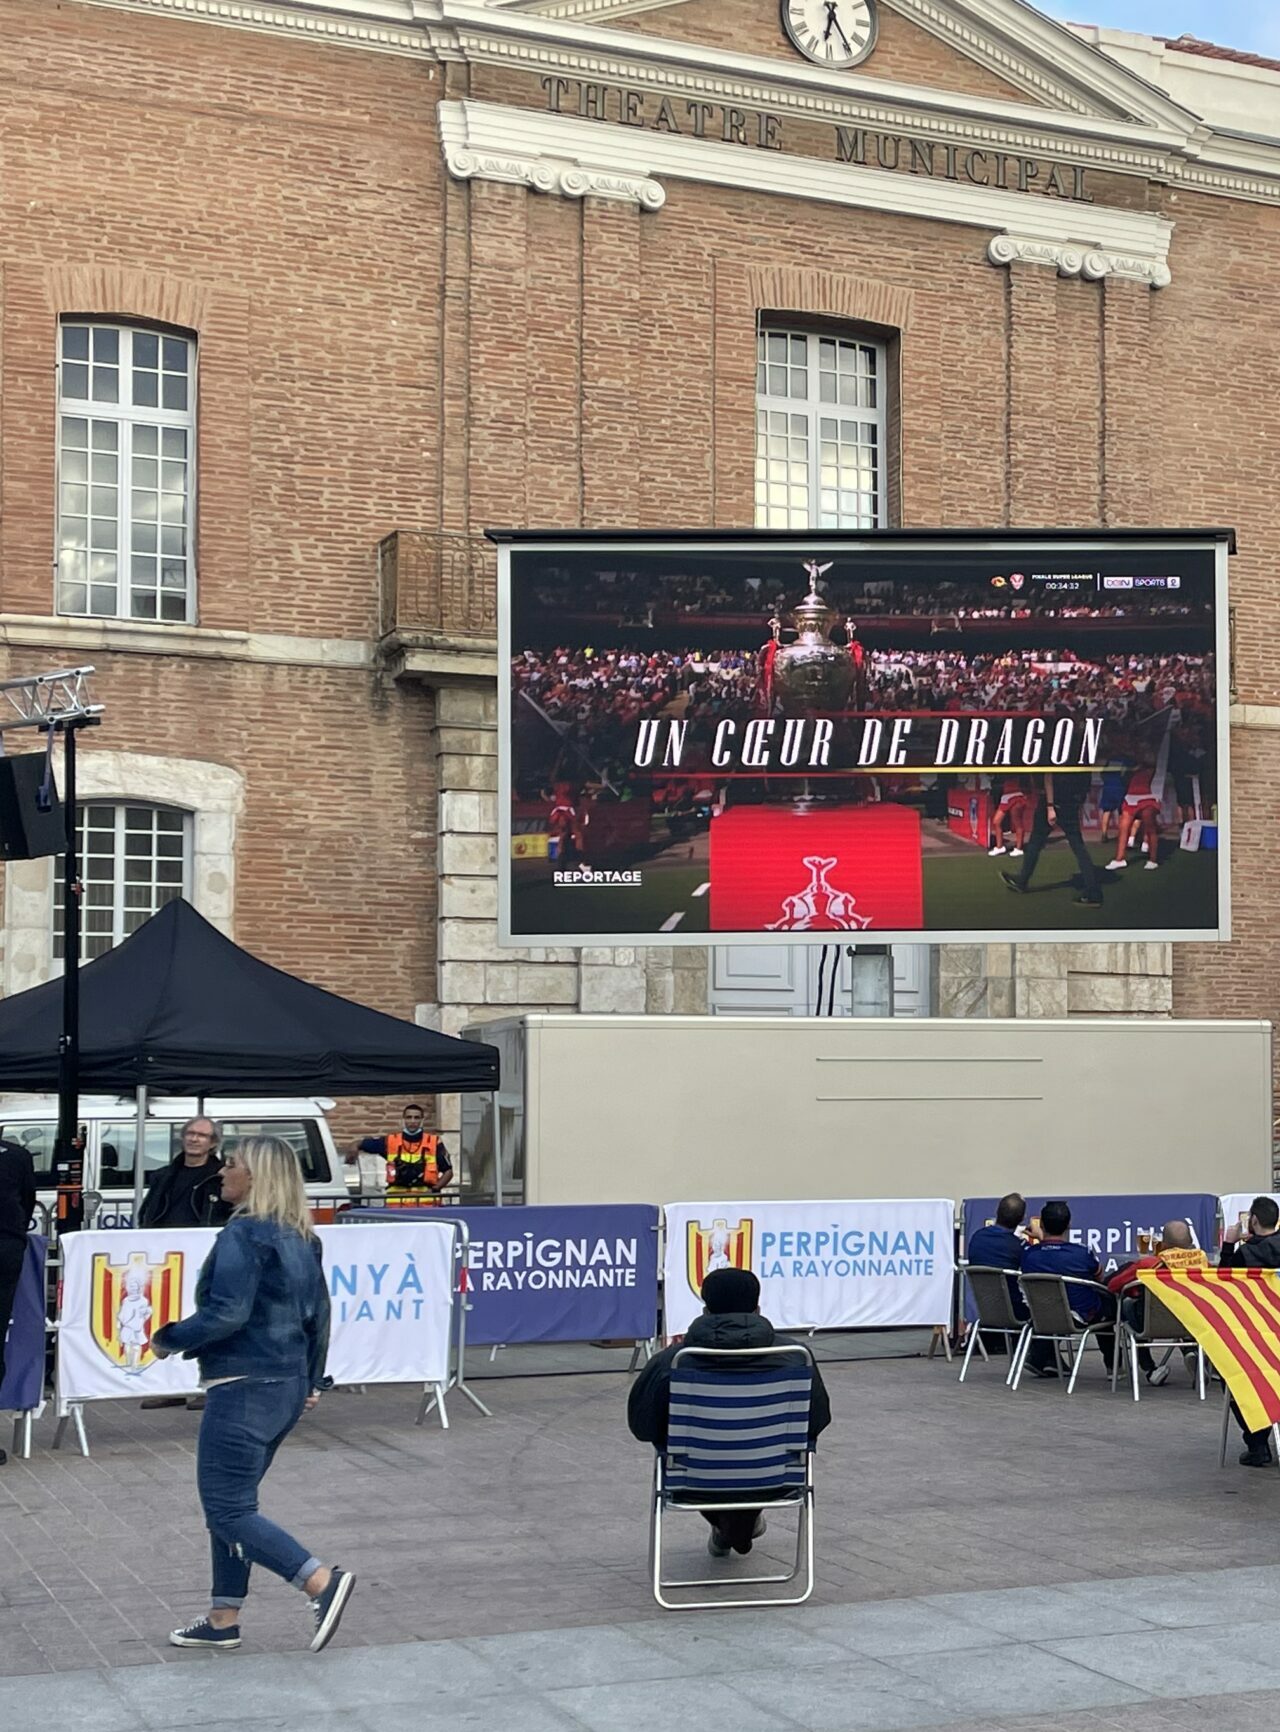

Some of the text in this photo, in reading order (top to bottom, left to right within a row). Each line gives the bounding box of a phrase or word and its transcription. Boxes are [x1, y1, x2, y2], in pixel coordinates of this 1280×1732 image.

[540, 76, 1094, 202] THEATRE MUNICIPAL
[633, 717, 1104, 766] UN CŒUR DE DRAGON
[553, 870, 642, 883] REPORTAGE
[482, 1268, 637, 1291] RAYONNANTE
[760, 1258, 934, 1278] LA RAYONNANTE
